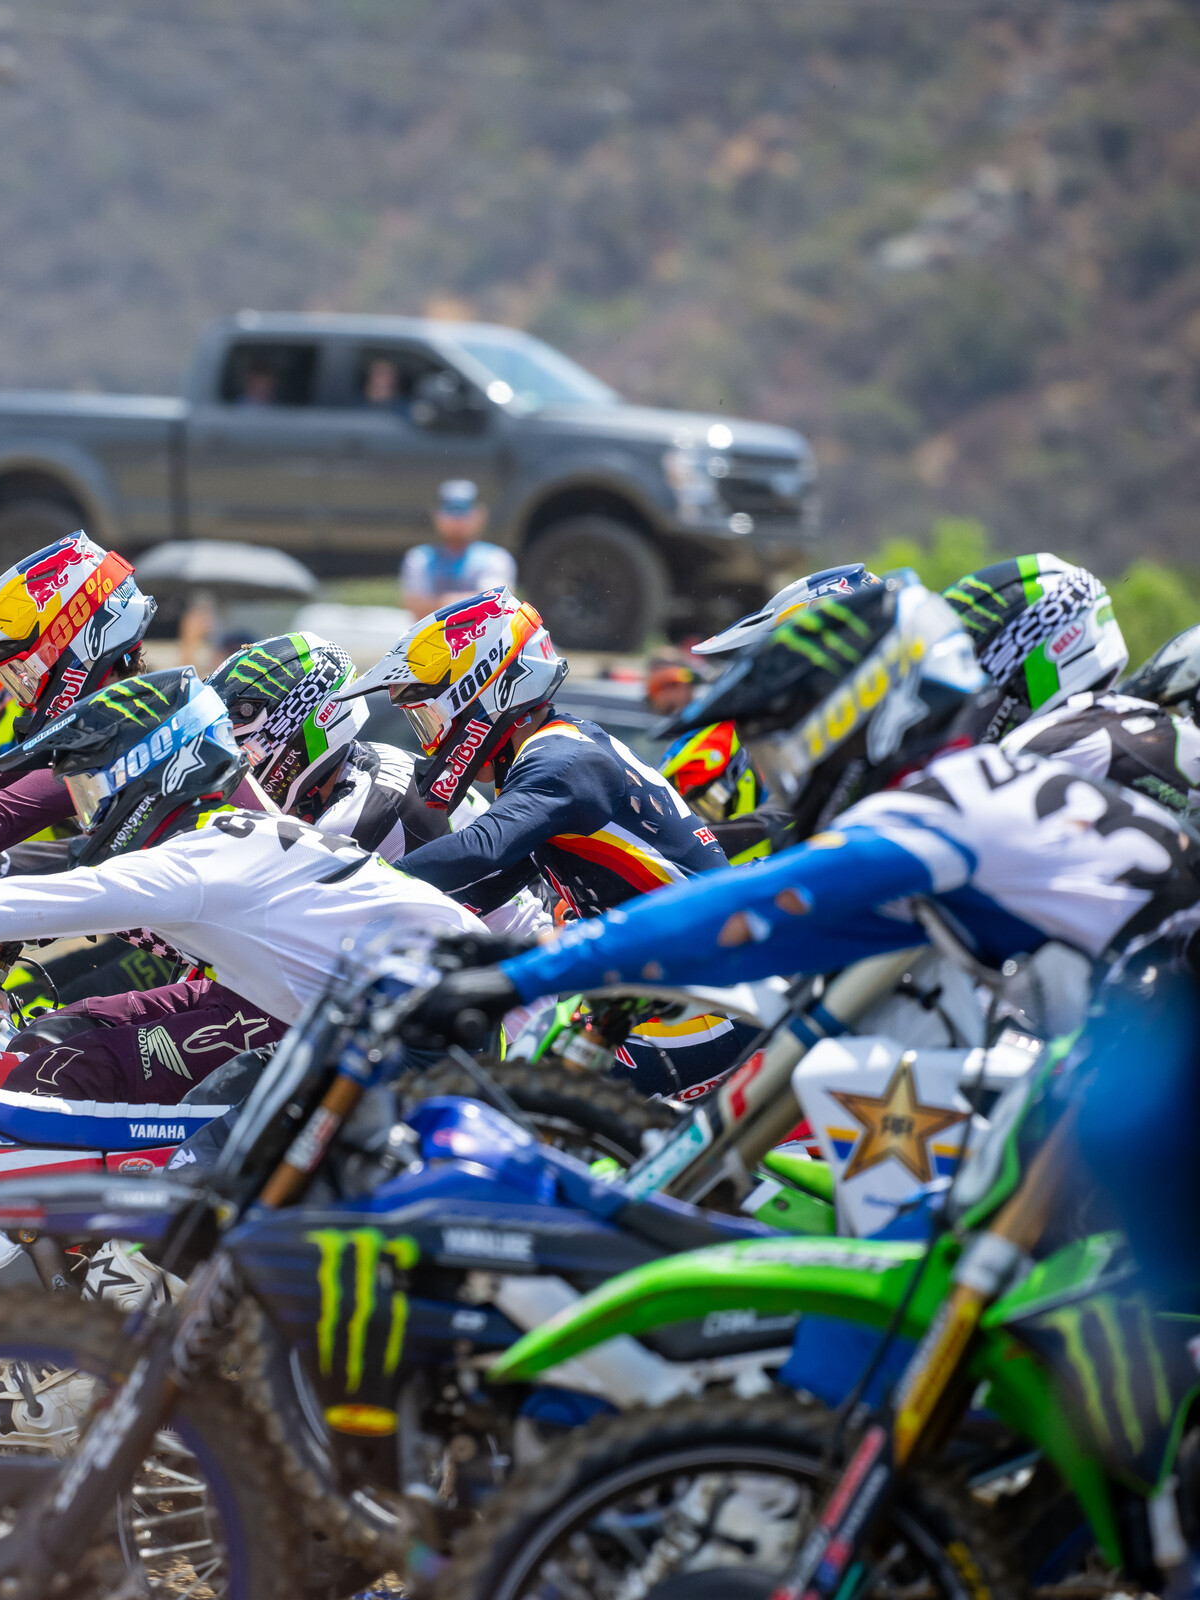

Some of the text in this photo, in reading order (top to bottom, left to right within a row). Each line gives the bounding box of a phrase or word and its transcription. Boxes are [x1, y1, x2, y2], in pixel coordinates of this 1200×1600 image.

[1052, 625, 1080, 654] BELL
[447, 638, 511, 712] 100%
[110, 712, 199, 789] 100%
[263, 749, 301, 794] ONSTER
[110, 795, 156, 851] MONSTER
[122, 806, 153, 847] ENERGY
[138, 1028, 153, 1081] HONDA
[129, 1124, 186, 1140] YAMAHA
